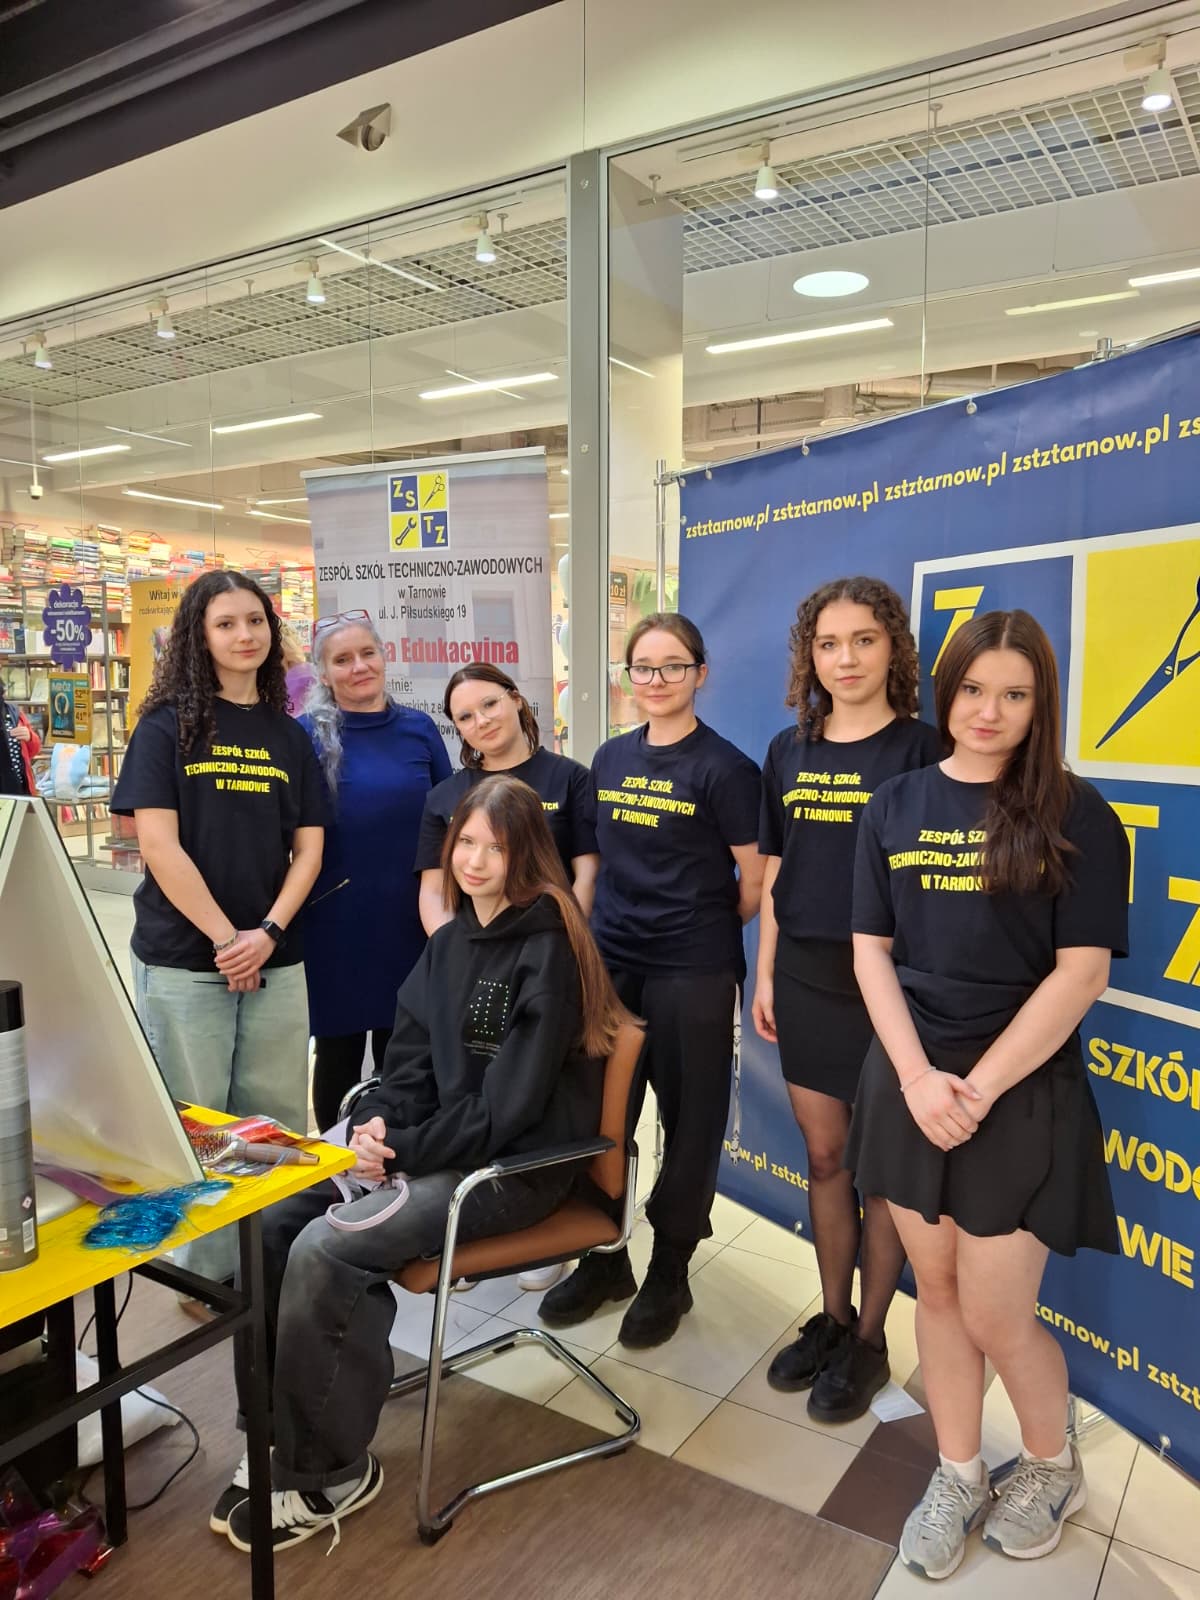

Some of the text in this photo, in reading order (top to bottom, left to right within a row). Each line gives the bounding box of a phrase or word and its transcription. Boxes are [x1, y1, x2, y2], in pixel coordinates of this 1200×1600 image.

[686, 413, 1200, 539] zstztarnow.pl zstztarnow.pl zstztarnow.pl zstztarnow.pl zs
[319, 557, 543, 581] ZESPÓŁ SZKÓŁ TECHNICZNO-ZAWODOWYCH
[398, 584, 446, 599] w Tarnowie
[379, 604, 467, 621] ul. J. Piłsudskiego 19
[50, 619, 85, 642] -50%
[401, 637, 519, 664] Edukacyjna
[211, 745, 271, 760] ZESPÓŁ SZKÓŁ
[215, 778, 271, 793] W TARNOWIE
[621, 775, 674, 794] ZESPÓŁ SZKÓŁ
[797, 772, 862, 785] ZESPÓŁ SZKÓŁ
[612, 807, 660, 828] W TARNOWIE
[804, 807, 853, 823] TARNOWIE
[918, 829, 966, 846] ZESPÓŁ
[920, 874, 932, 890] W
[1116, 1215, 1195, 1289] WIE
